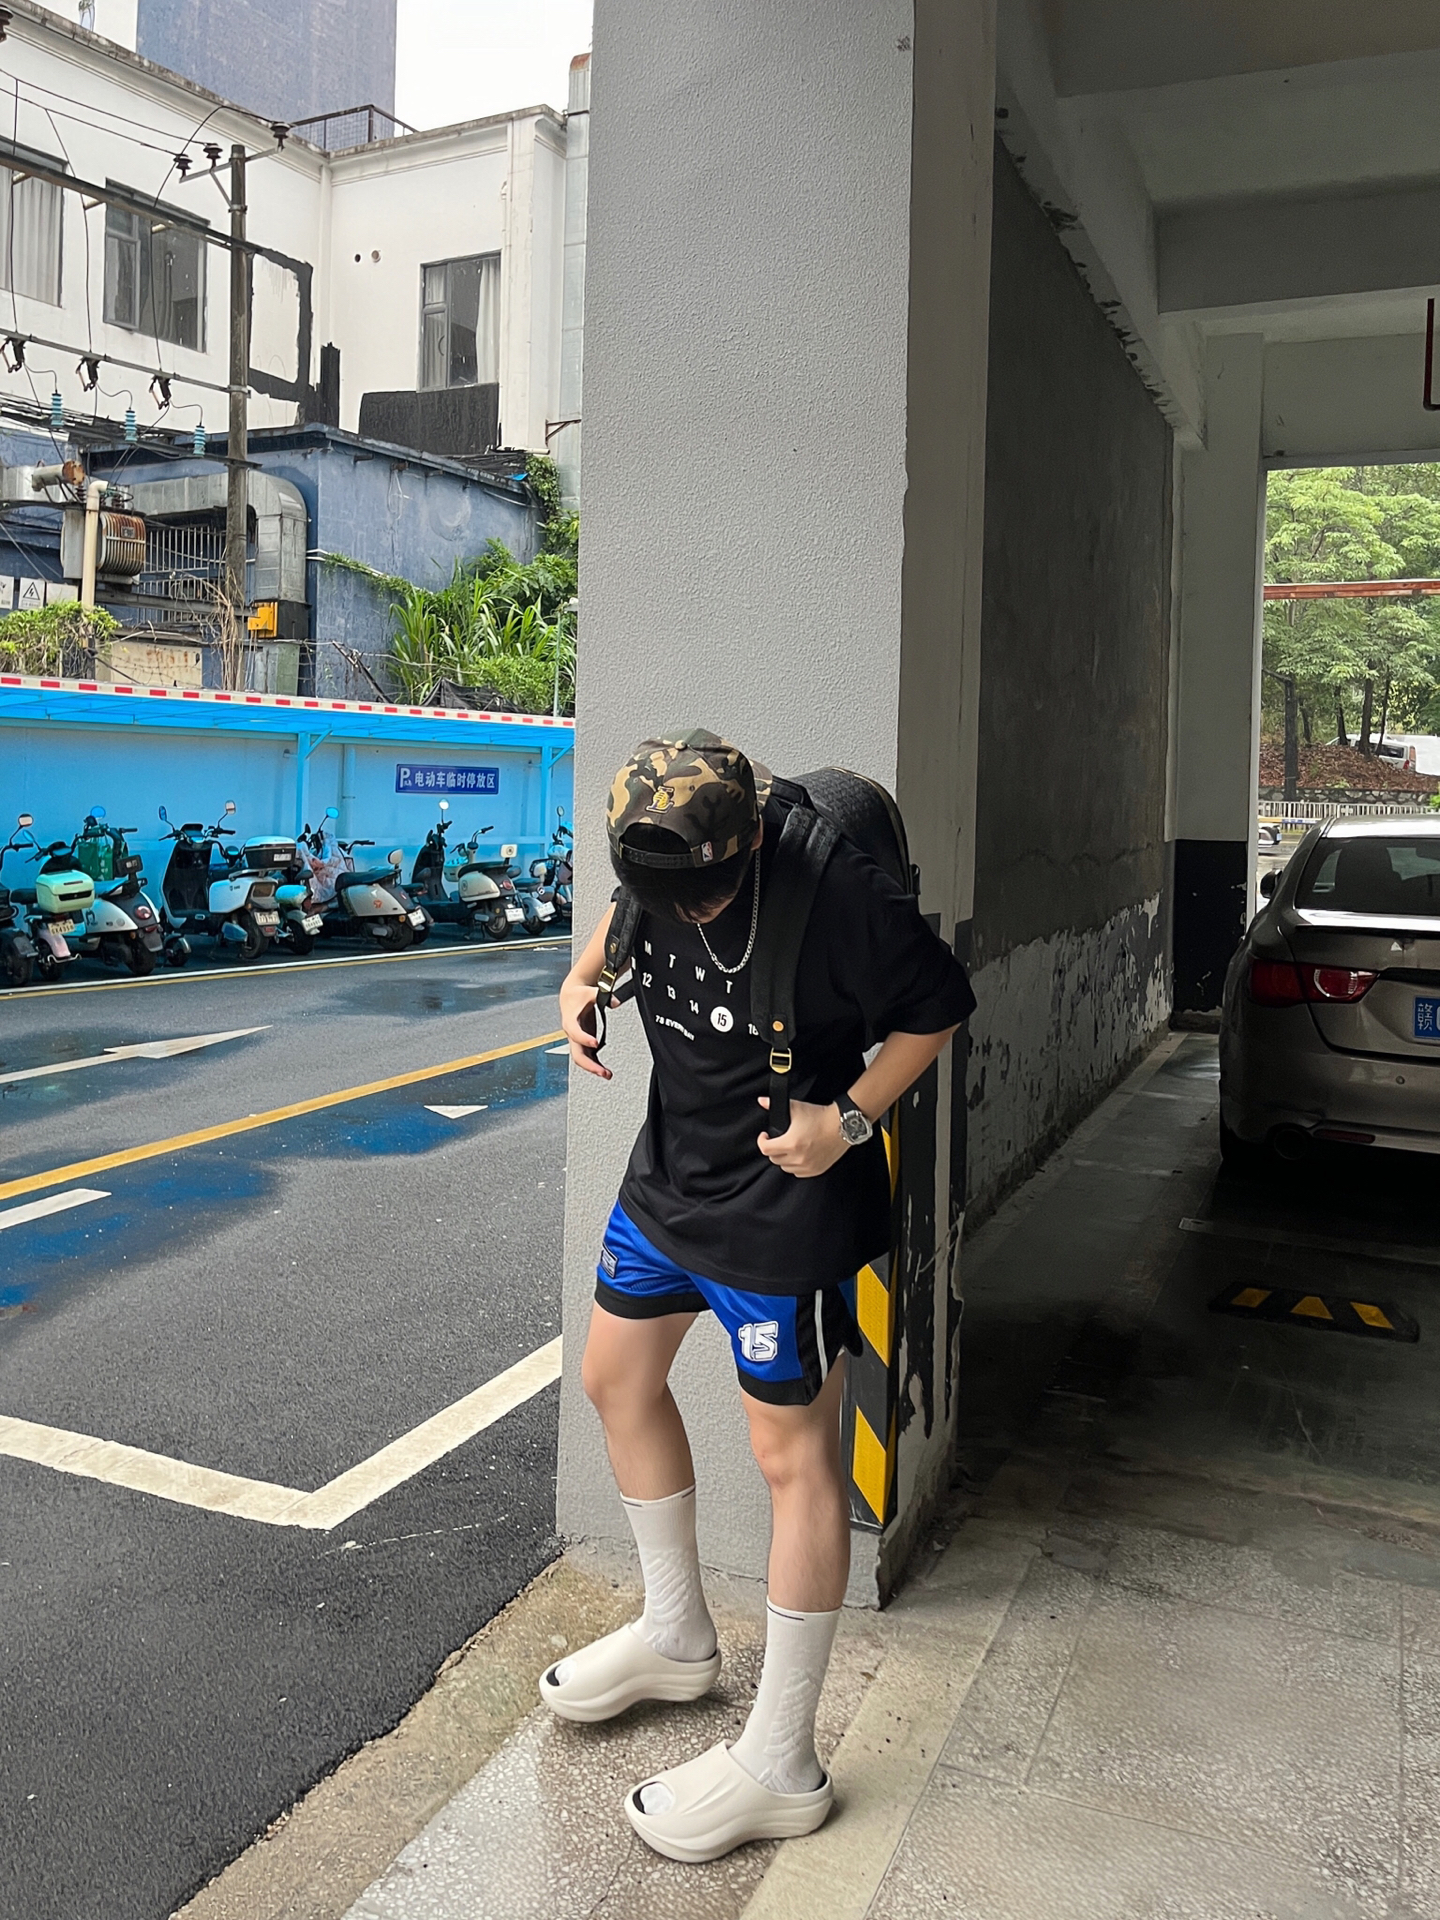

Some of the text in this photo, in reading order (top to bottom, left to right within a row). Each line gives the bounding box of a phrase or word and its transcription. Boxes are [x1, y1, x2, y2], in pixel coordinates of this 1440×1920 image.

[400, 767, 496, 789] P 电动车临时停放区
[644, 940, 733, 994] M T W T
[642, 972, 653, 988] 12
[666, 985, 676, 1000] 13
[689, 999, 699, 1015] 14
[717, 1012, 727, 1027] 15
[748, 1022, 759, 1036] 16
[738, 1321, 779, 1361] 15
